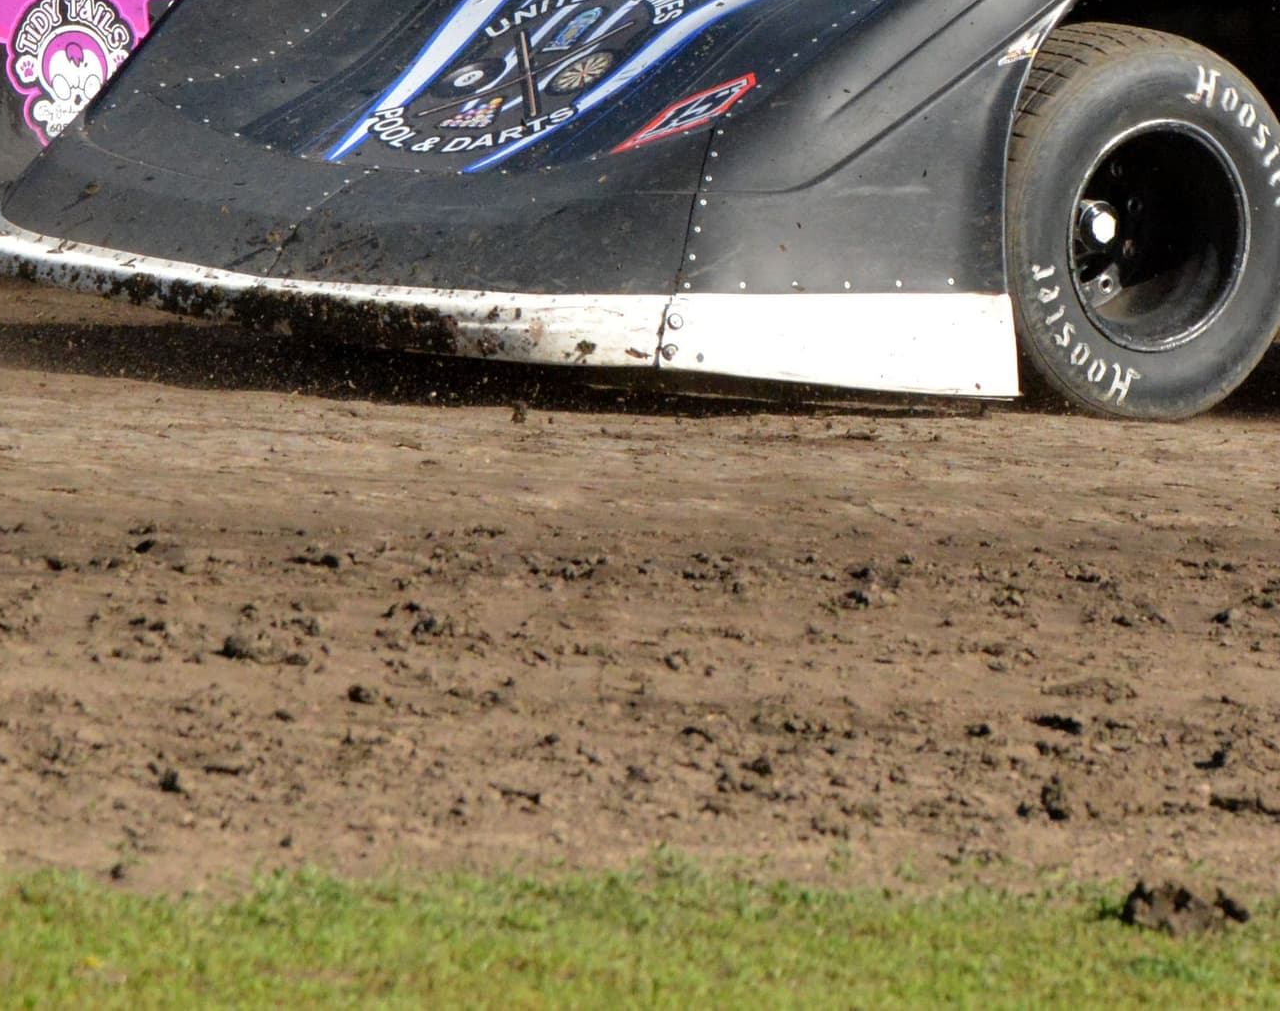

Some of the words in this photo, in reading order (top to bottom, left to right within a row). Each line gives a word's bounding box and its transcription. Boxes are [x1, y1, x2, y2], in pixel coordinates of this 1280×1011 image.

[372, 106, 420, 149] POOL
[410, 136, 441, 153] &
[440, 107, 576, 153] DARTS
[1031, 264, 1142, 406] Hoosier
